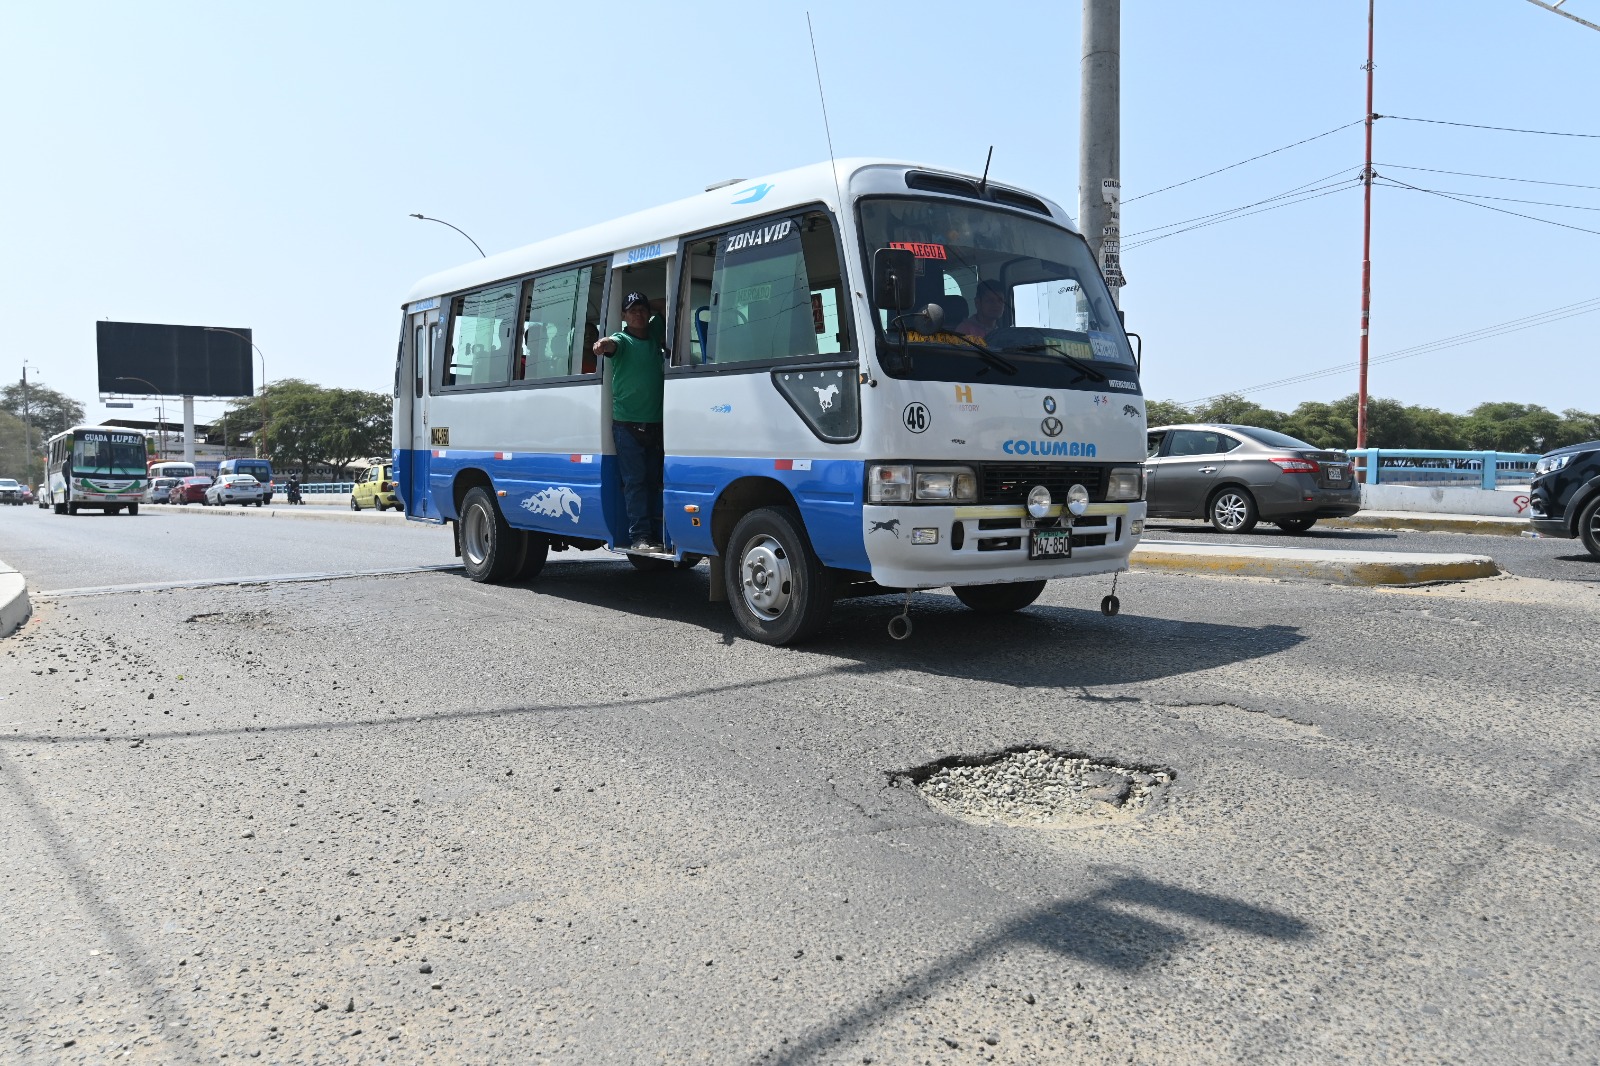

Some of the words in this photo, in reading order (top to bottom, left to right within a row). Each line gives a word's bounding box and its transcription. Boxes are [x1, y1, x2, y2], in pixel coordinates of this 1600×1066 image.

[628, 243, 661, 263] SUBIDA
[911, 244, 944, 258] LEGUA
[955, 384, 973, 403] H
[907, 406, 925, 429] 46
[84, 433, 108, 442] GUADA
[1003, 440, 1096, 457] COLUMBIA
[1032, 537, 1069, 555] M4Z-850
